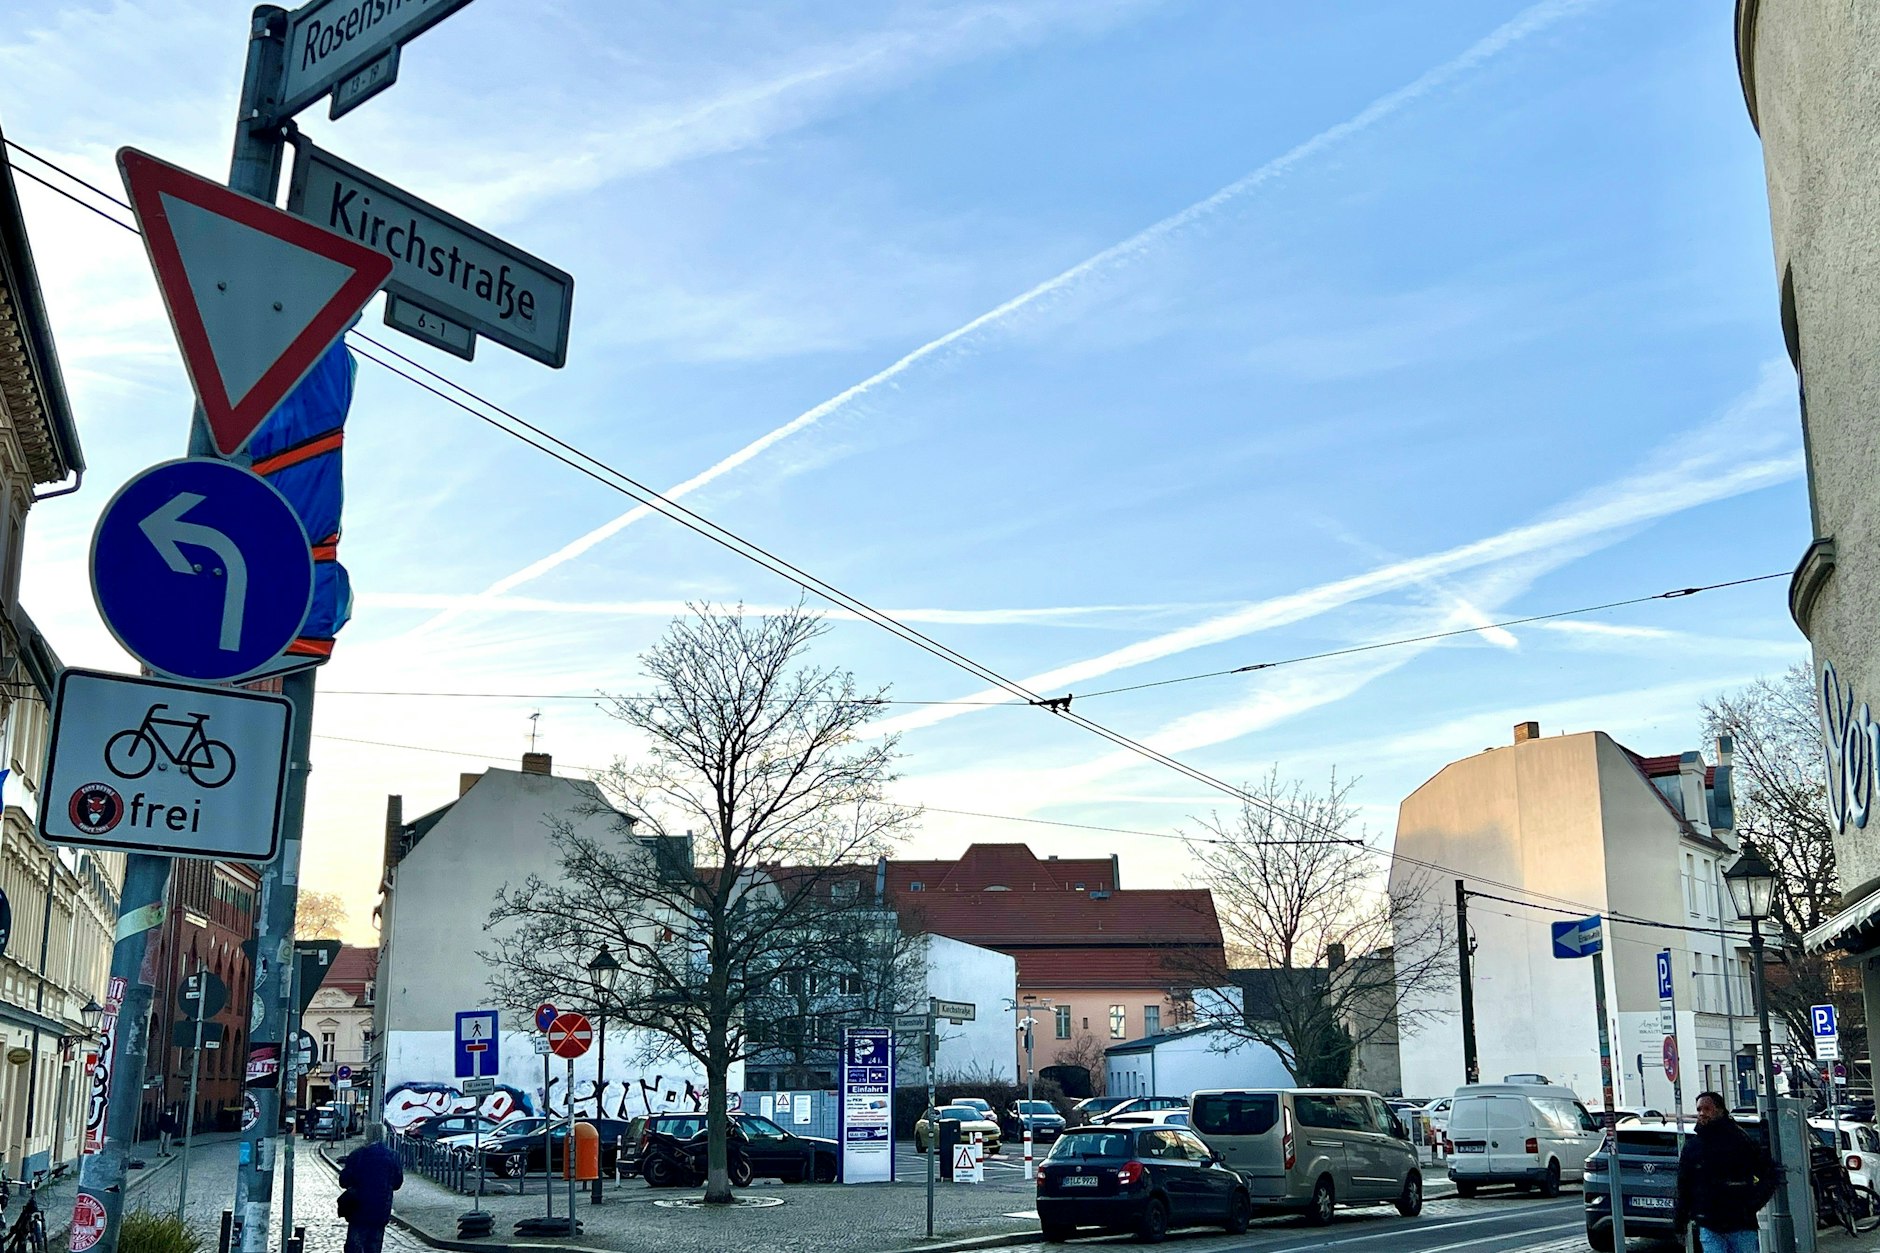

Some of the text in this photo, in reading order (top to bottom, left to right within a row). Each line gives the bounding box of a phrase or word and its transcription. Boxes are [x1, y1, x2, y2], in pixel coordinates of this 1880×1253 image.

[302, 0, 428, 71] Rosens
[330, 181, 535, 320] Kirchstraße
[131, 793, 201, 833] frei
[942, 1004, 971, 1016] Kirchstraße
[1815, 1010, 1828, 1033] P
[852, 1085, 884, 1093] Einfahrt
